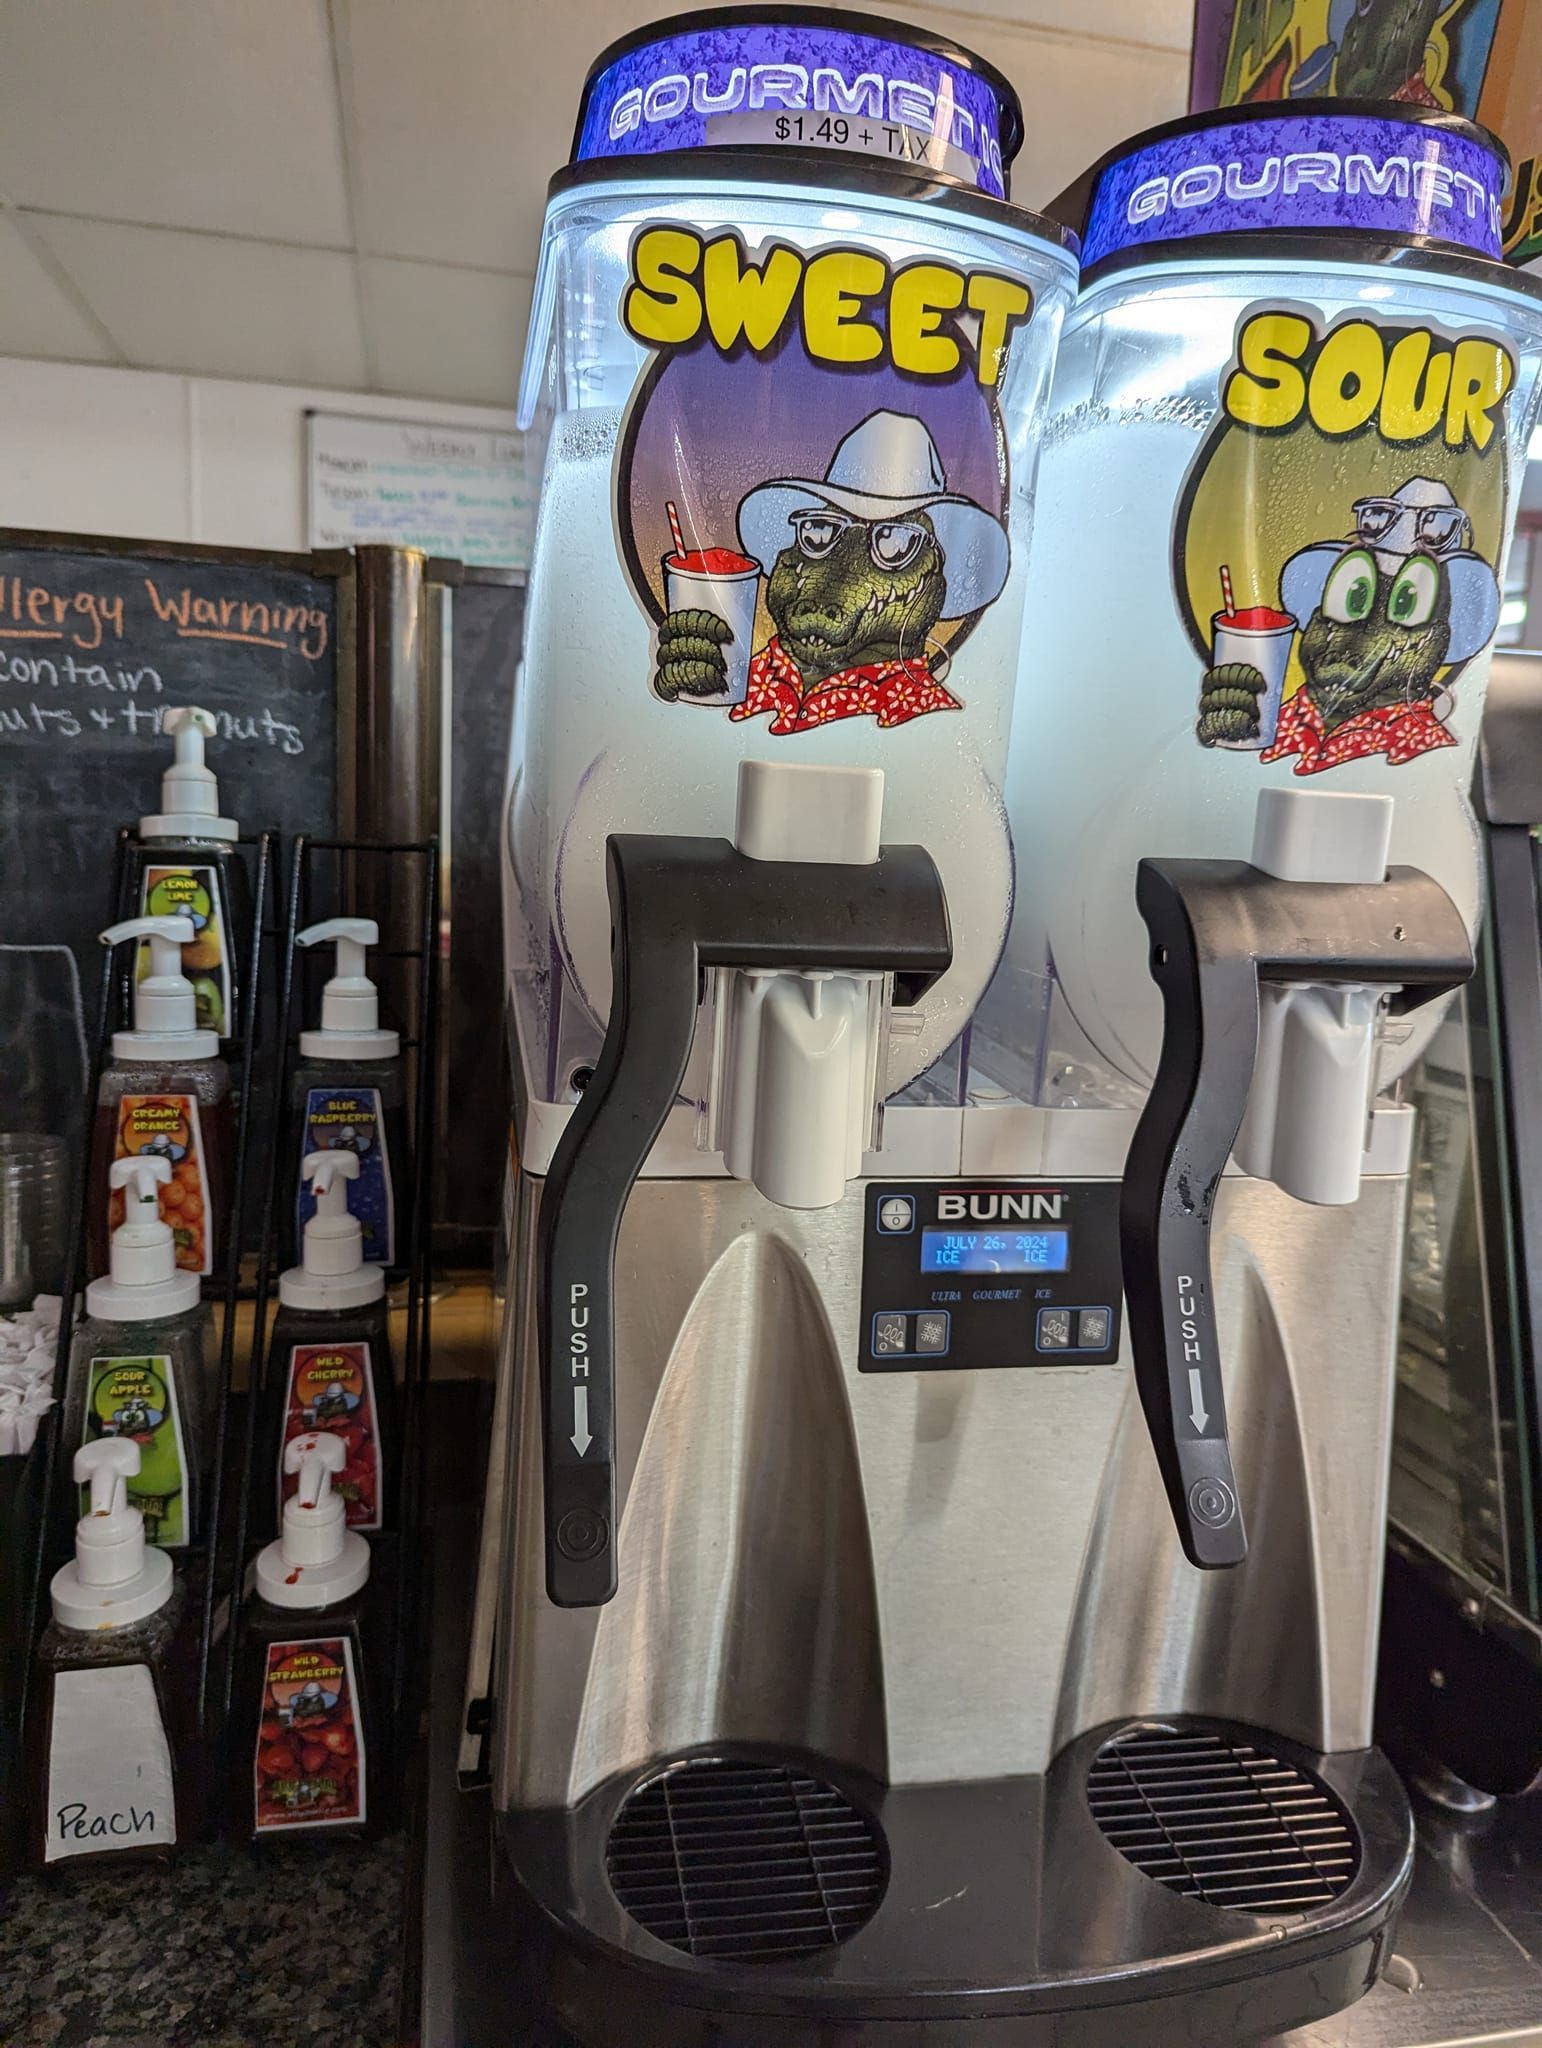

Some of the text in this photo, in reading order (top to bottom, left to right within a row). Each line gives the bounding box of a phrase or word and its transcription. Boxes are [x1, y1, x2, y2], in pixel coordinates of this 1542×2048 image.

[609, 64, 976, 147] GOURMET
[775, 115, 850, 145] $1.49
[882, 127, 930, 162] TAX
[1127, 152, 1484, 225] GOURMET
[624, 226, 1033, 388] SWEET
[1224, 311, 1513, 456] SOUR
[145, 578, 328, 660] Warning
[163, 880, 198, 889] LEMON
[132, 1108, 181, 1119] CREAMY
[327, 1101, 357, 1111] BLUE
[309, 1112, 377, 1124] RASPBERRY
[133, 1120, 180, 1132] ORANGE
[943, 1236, 977, 1251] JULY
[1016, 1235, 1049, 1250] 2024
[935, 1249, 1048, 1265] ICE ICE
[931, 1288, 1052, 1302] ULTRA GOURMET ICE
[1177, 1275, 1201, 1362] PUSH
[570, 1283, 590, 1378] PUSH
[316, 1356, 345, 1367] WILD
[114, 1370, 146, 1382] SOUR
[307, 1368, 355, 1381] CHERRY
[109, 1383, 152, 1396] APPLE
[294, 1655, 320, 1666] WILD
[268, 1666, 345, 1681] STRAWBERRY
[57, 1803, 154, 1839] Peach
